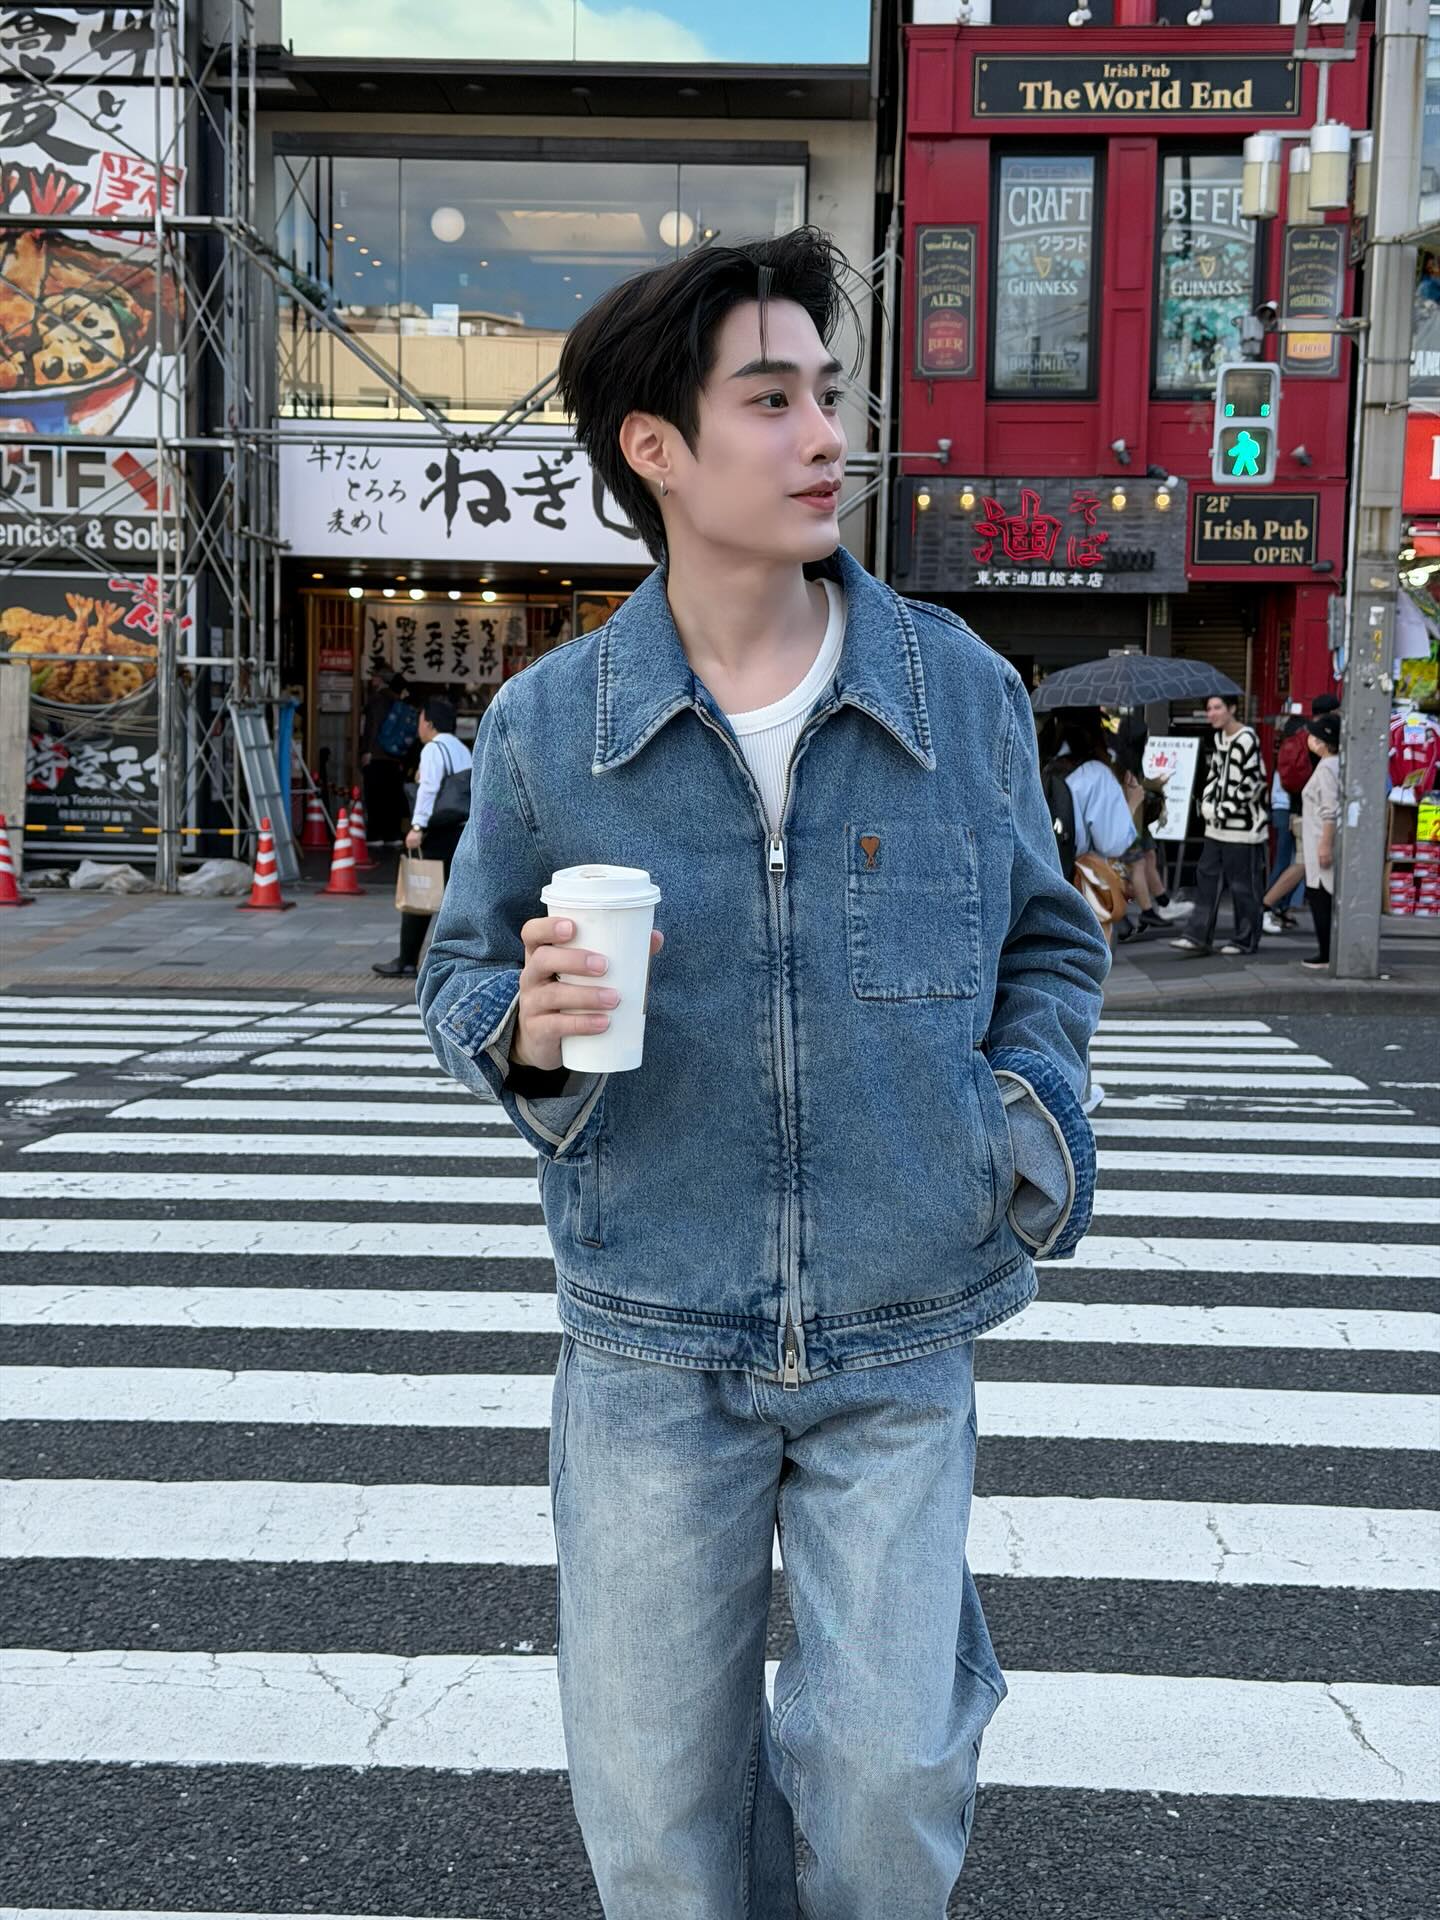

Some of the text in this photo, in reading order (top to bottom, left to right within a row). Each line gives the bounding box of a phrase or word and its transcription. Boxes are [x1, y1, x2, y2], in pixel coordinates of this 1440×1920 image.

[1103, 64, 1171, 78] Irish Pub
[1019, 80, 1253, 110] The World End
[1008, 186, 1092, 227] CRAFT
[1039, 236, 1087, 253] クラフト
[1172, 234, 1211, 250] ビール
[1007, 280, 1078, 297] GUINNESS
[1170, 280, 1242, 297] GUINNESS
[930, 293, 962, 307] ALES
[307, 447, 380, 472] 牛たん
[347, 479, 407, 502] とろろ
[1206, 496, 1231, 513] 2F
[327, 510, 388, 535] 麦めし
[1203, 520, 1309, 540] Irish Pub
[85, 519, 106, 549] &
[113, 519, 185, 551] Soba
[1254, 547, 1304, 563] OPEN
[974, 570, 1104, 588] 東京油組総本店
